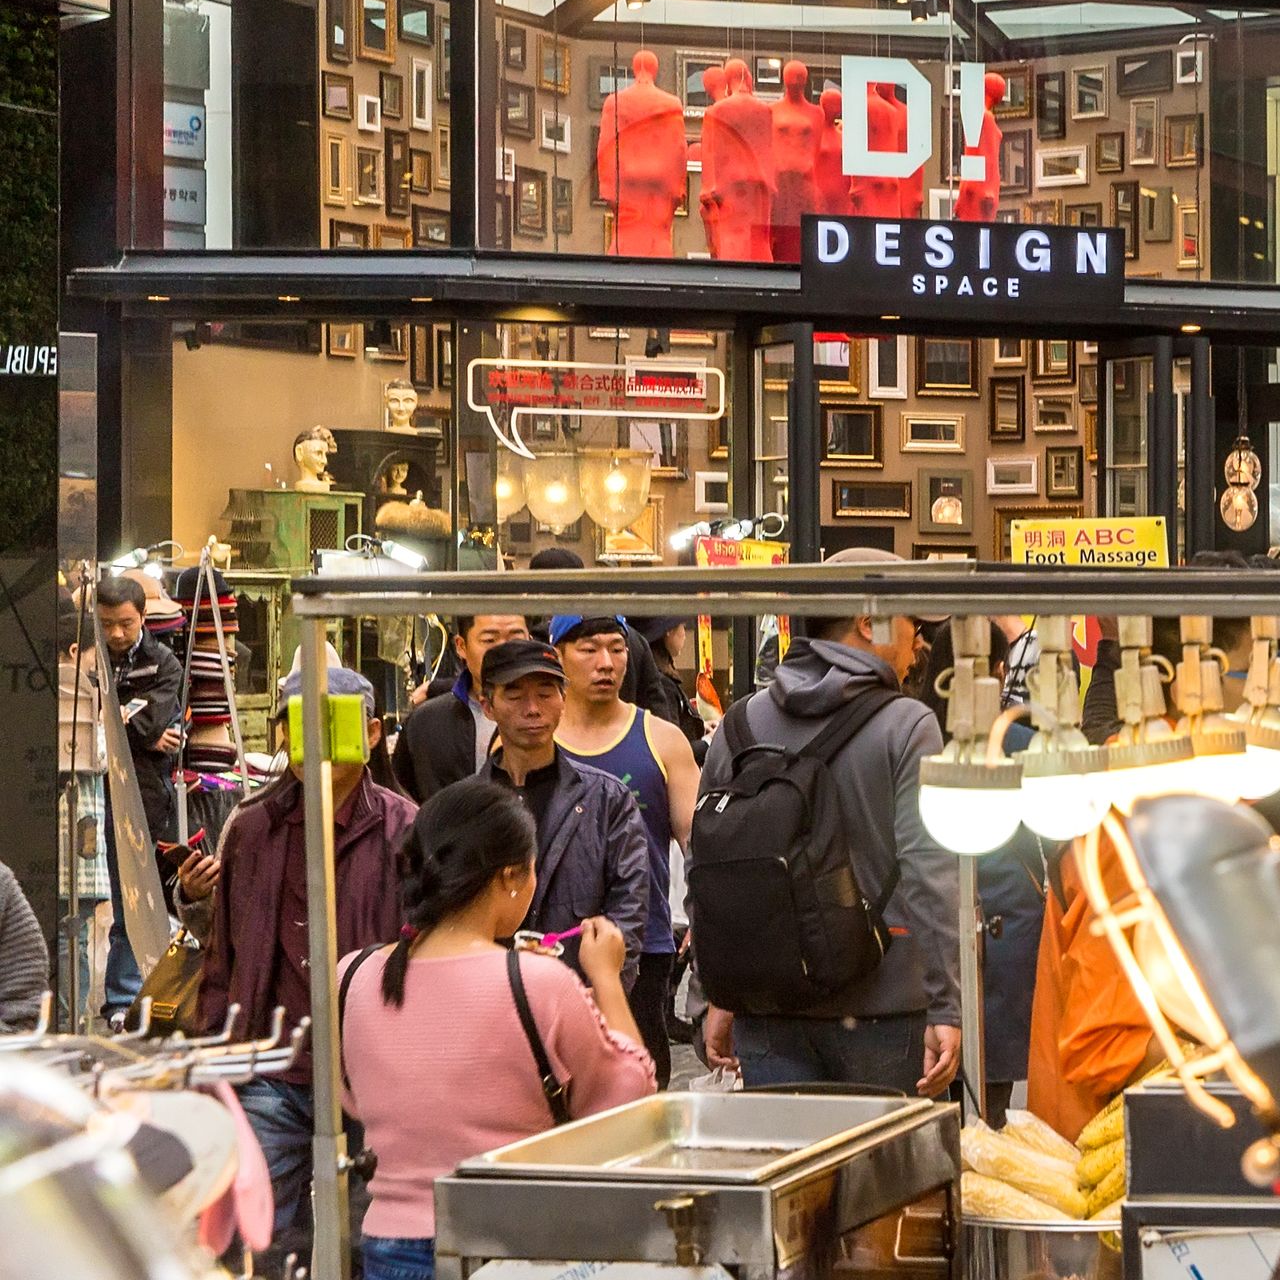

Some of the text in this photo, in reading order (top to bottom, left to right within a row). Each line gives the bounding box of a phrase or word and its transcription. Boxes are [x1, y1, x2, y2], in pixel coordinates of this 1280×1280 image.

[841, 56, 986, 182] D!
[816, 220, 1107, 274] DESIGN
[912, 273, 1019, 298] SPACE
[1024, 528, 1136, 548] 明洞 ABC
[1025, 548, 1157, 567] Foot Massage
